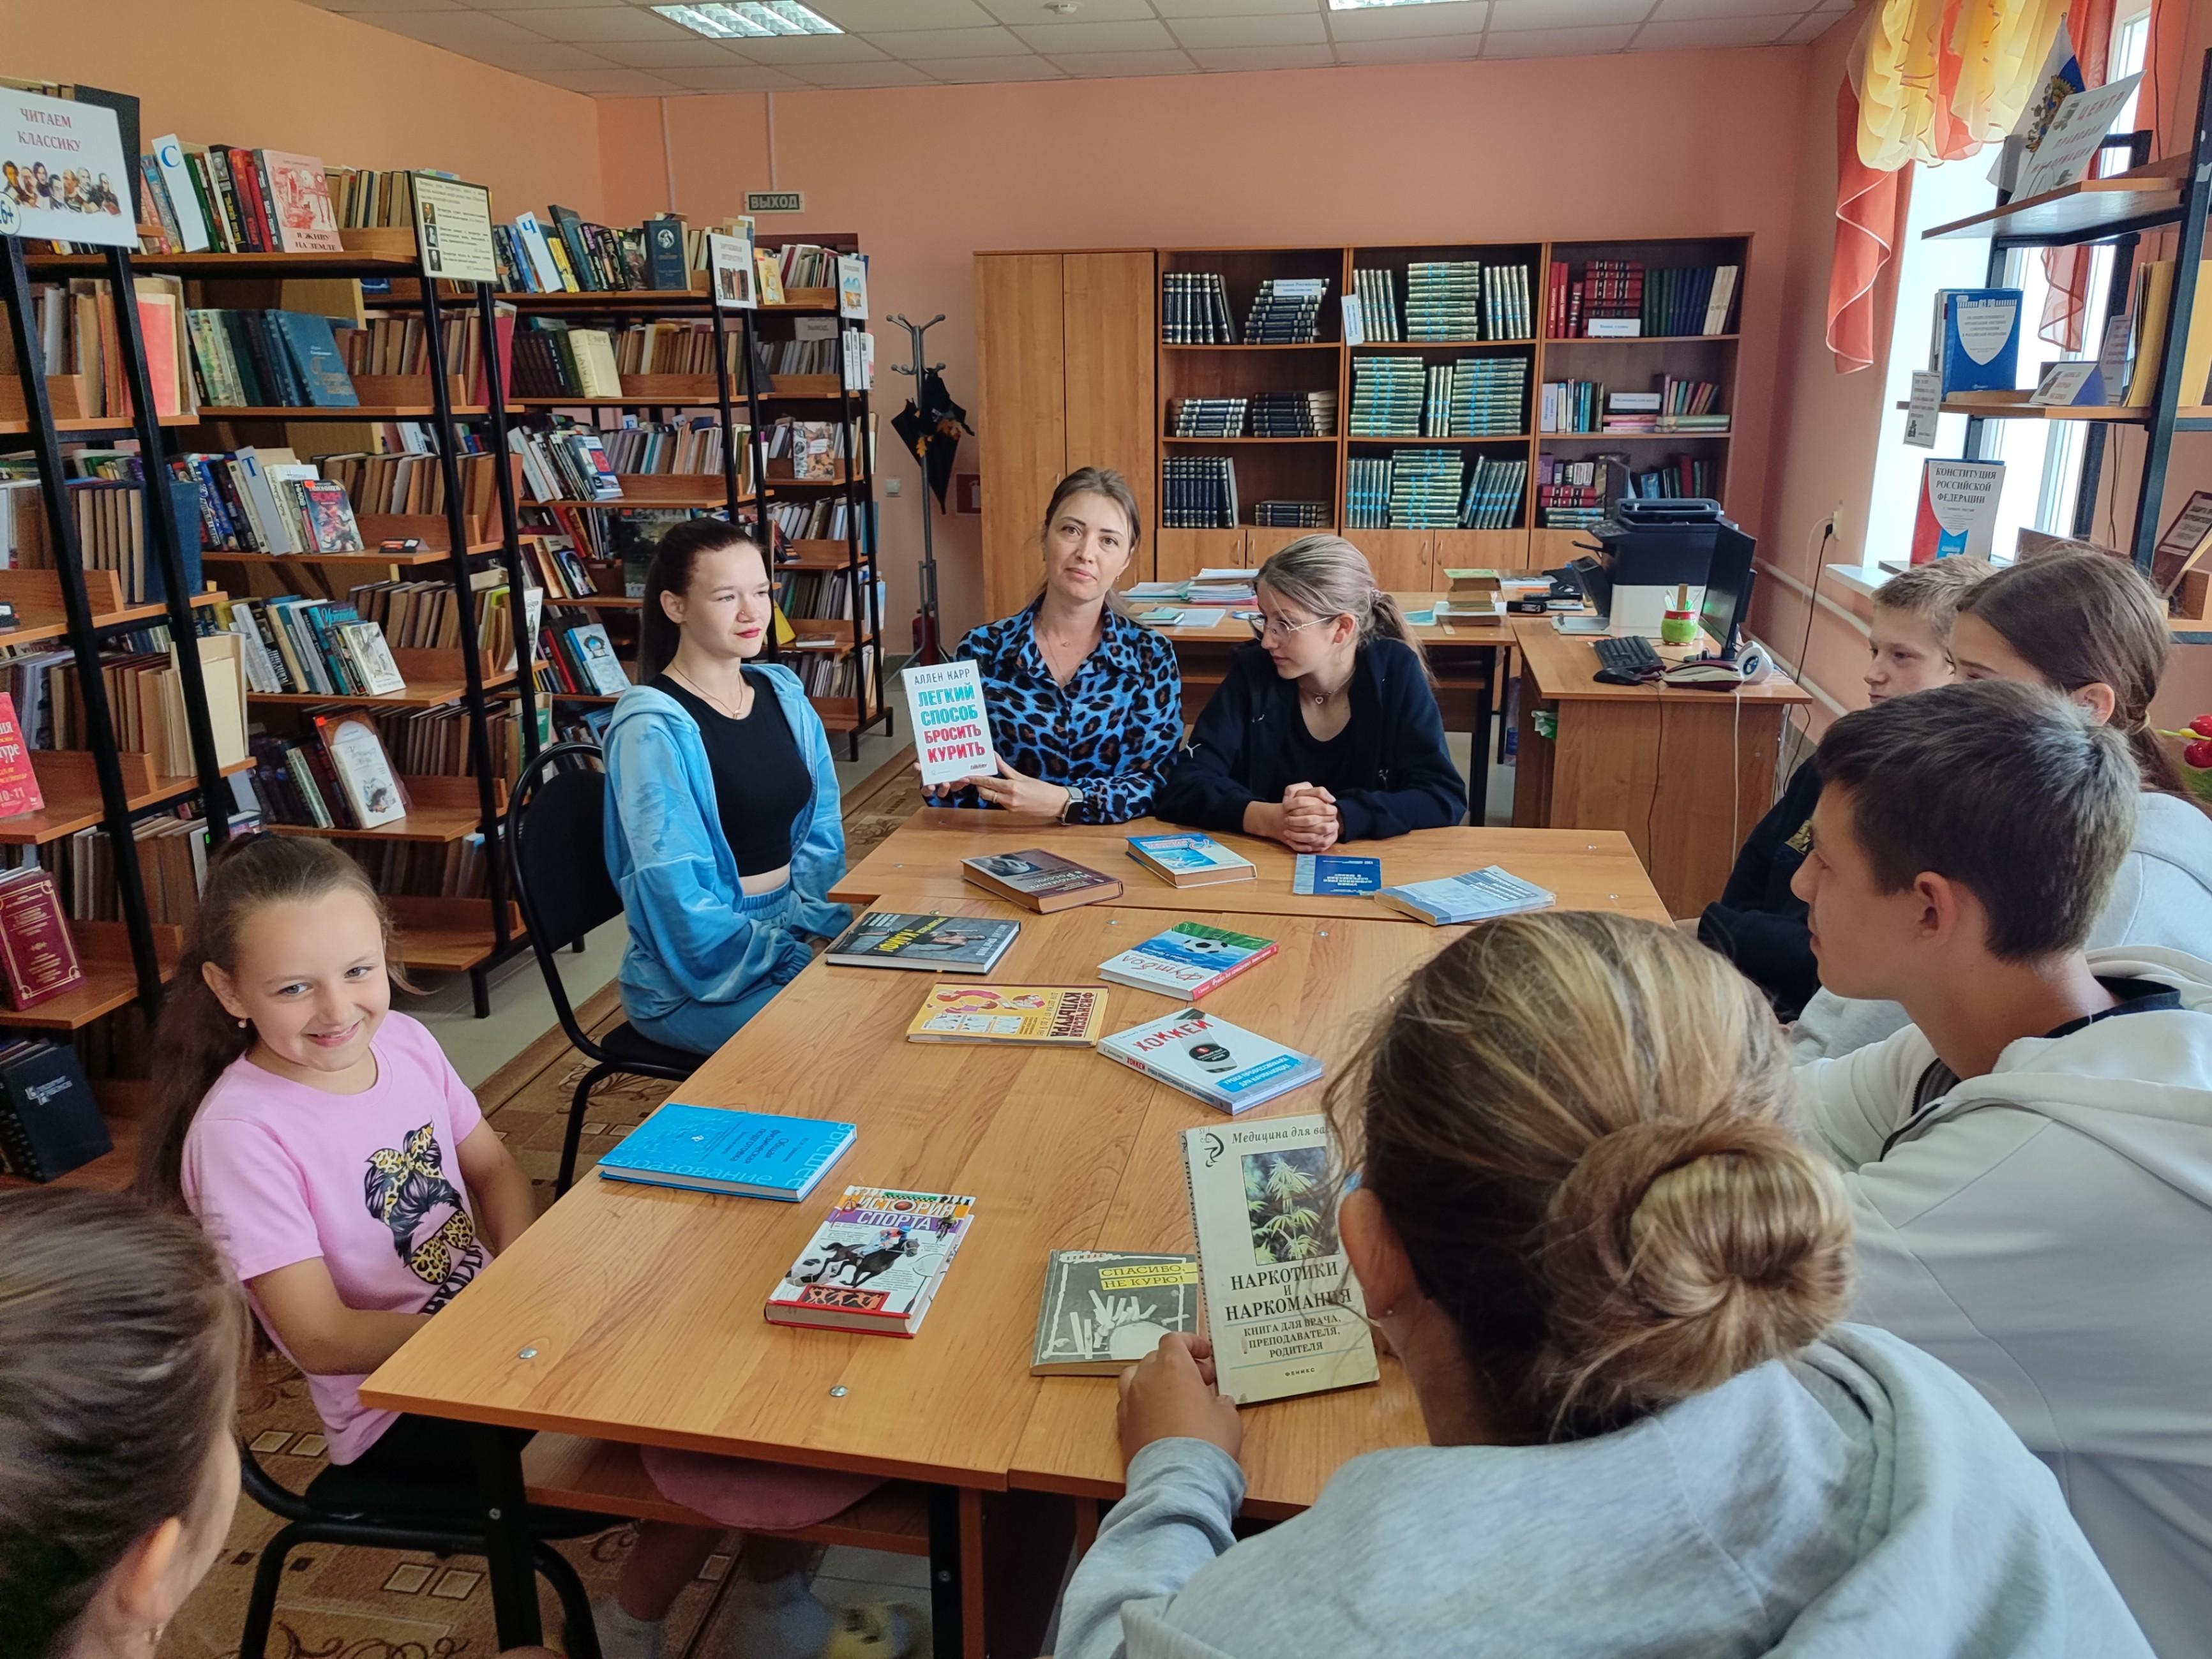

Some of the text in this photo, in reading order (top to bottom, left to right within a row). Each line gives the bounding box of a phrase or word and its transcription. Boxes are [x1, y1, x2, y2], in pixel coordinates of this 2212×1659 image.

[2077, 91, 2125, 121] ЦЕНТР
[20, 108, 71, 128] ЧИТАЕМ
[17, 131, 81, 152] КЛАССИКУ
[161, 144, 181, 169] С
[749, 195, 799, 209] ВЫХОД
[521, 218, 538, 235] Ч
[241, 456, 257, 477] Т
[1936, 467, 1997, 479] КОНСТИТУЦИЯ
[1936, 480, 1992, 492] РОССИЙСКОЙ
[1937, 492, 1986, 504] ФЕДЕРАЦИИ
[914, 668, 970, 685] АЛЛЕН КАРР
[918, 682, 975, 707] ЛЕГКИЙ
[921, 705, 978, 726] СПОСОБ
[924, 724, 982, 744] БРОСИТЬ
[927, 741, 985, 763] КУРИТЬ
[1122, 955, 1205, 982] Футбол
[1050, 992, 1081, 1038] КУЛЬТУРА
[1072, 992, 1095, 1037] ФИЗИЧЕСКАЯ
[1132, 1019, 1214, 1052] ХОККЕЙ
[1127, 1056, 1145, 1071] ХОККЕЙ
[726, 1128, 769, 1162] подготовка
[1231, 1126, 1328, 1145] Медицина для ва
[739, 1129, 784, 1164] физическая
[760, 1137, 791, 1159] Общая
[859, 1197, 956, 1217] ИСТОРИЯ
[856, 1211, 931, 1230] СПОРТА
[1101, 1265, 1185, 1277] СПАСИБО,
[1230, 1261, 1339, 1291] НАРКОТИКИ
[1104, 1275, 1184, 1289] НЕ КУРЮ!
[1283, 1285, 1291, 1296] И
[1225, 1288, 1353, 1321] НАРКОМАНИЯ
[1244, 1315, 1341, 1337] КНИГА ДЛЯ ВРАЧА,
[1249, 1327, 1341, 1349] ПРЕПОДАВАТЕЛЯ,
[1270, 1342, 1323, 1358] РОДИТЕЛЯ
[1284, 1367, 1315, 1377] ФЕНИКС
